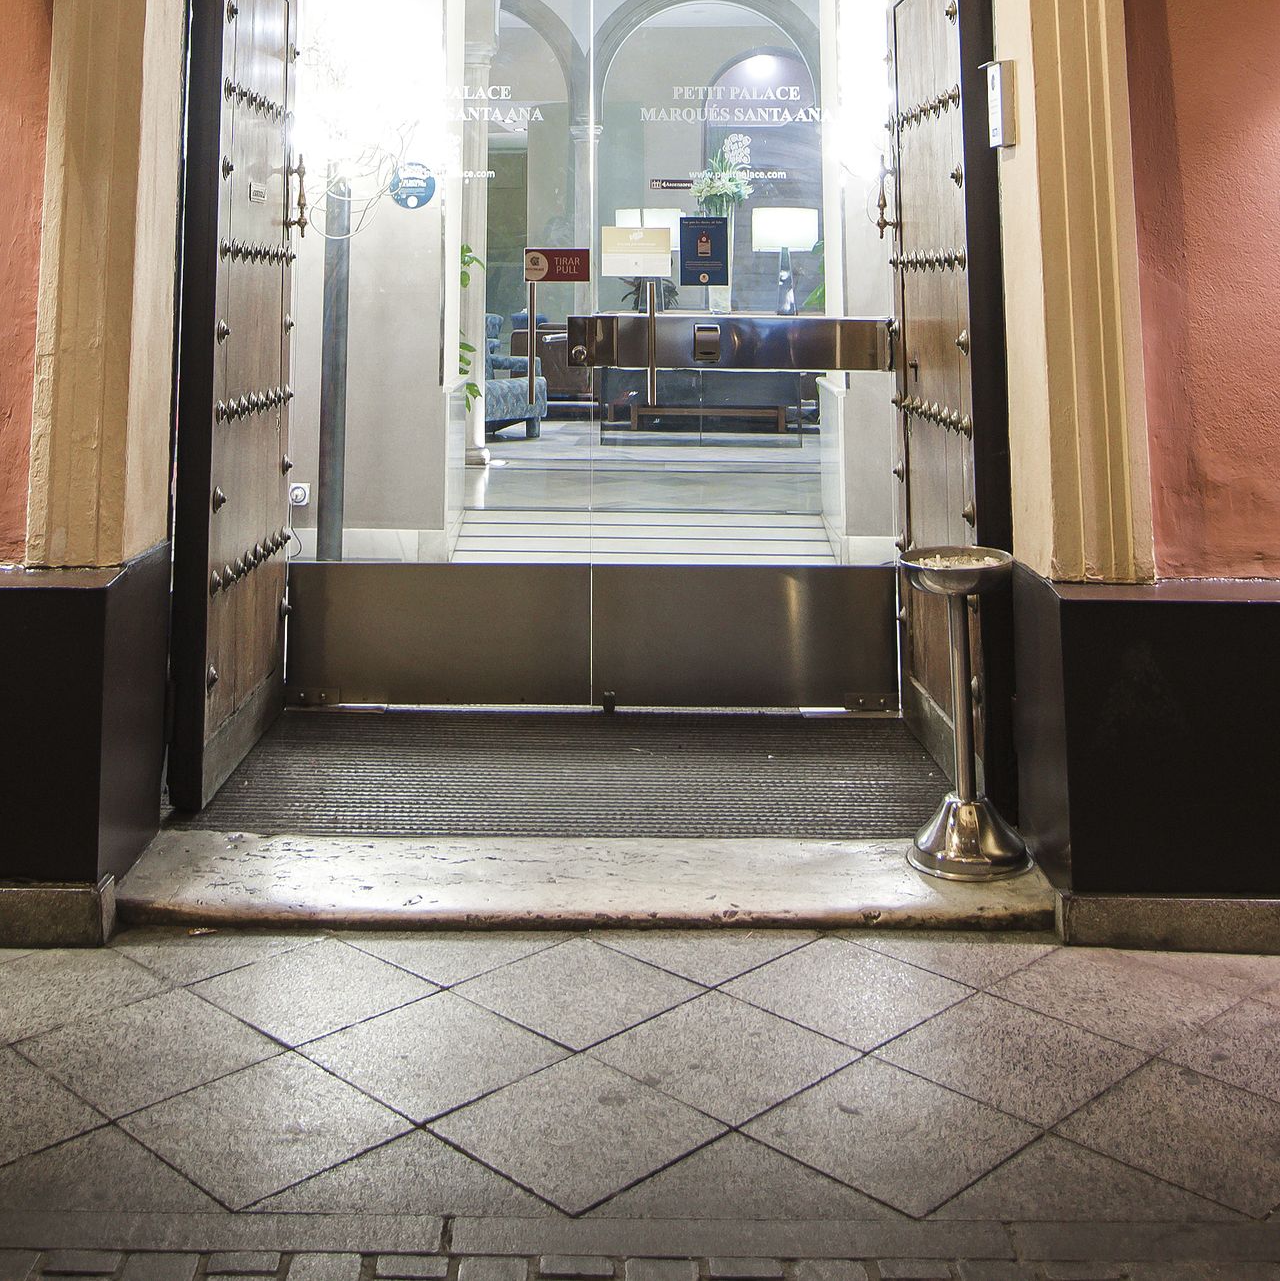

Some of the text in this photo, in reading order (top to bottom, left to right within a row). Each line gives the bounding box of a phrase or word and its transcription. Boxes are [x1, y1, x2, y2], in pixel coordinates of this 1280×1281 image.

[672, 86, 801, 101] PETIT PALACE
[505, 107, 544, 121] ANA
[640, 104, 730, 123] MARQUÉS
[734, 107, 793, 122] SANTA
[554, 256, 581, 266] TIRAR
[556, 266, 579, 274] PULL
